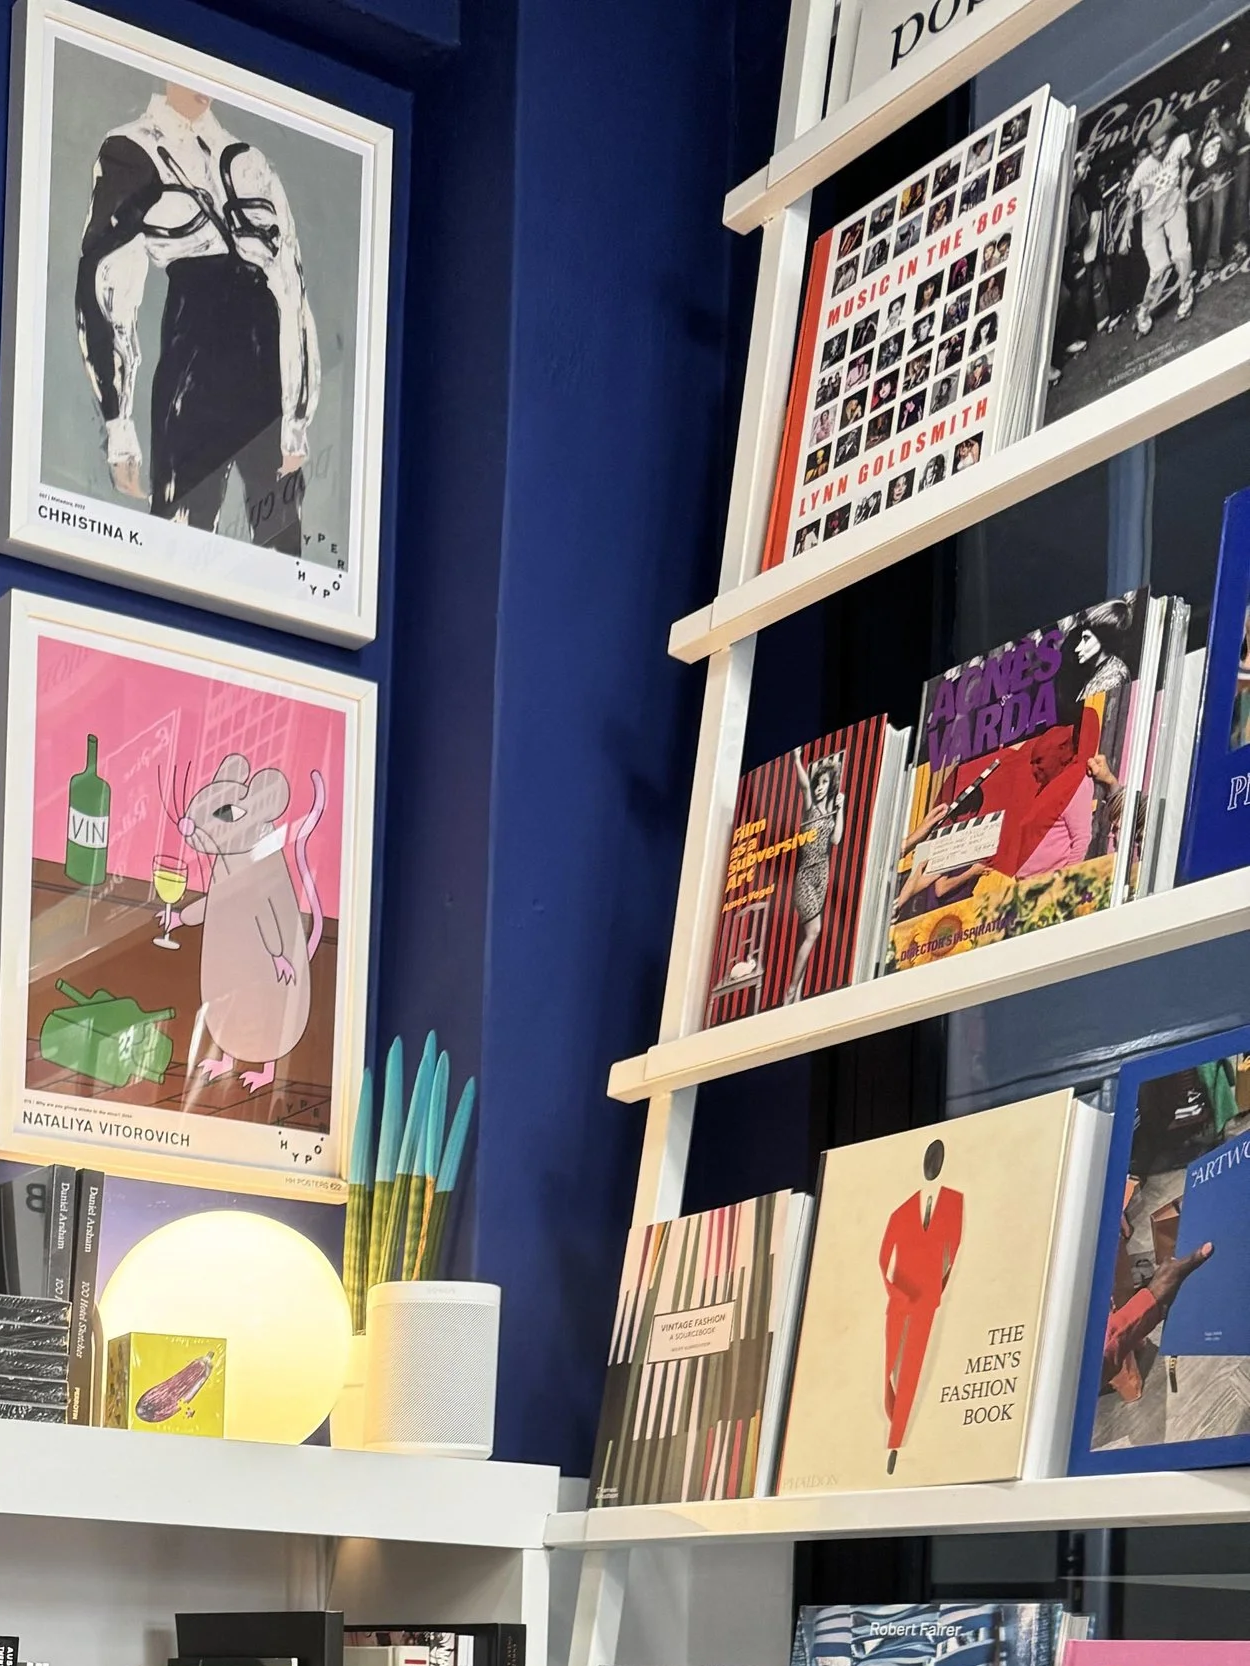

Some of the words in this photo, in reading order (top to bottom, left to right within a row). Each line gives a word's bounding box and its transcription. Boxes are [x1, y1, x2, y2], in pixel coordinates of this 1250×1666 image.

[826, 272, 889, 329] MUSIC
[897, 260, 918, 287] IN
[927, 230, 963, 274] THE
[972, 196, 1017, 241] '80S
[798, 472, 849, 519] LYNN
[857, 397, 988, 487] GOLDSMITH
[38, 505, 124, 542] CHRISTINA
[129, 531, 143, 547] K.
[926, 680, 1059, 774] VARDA
[72, 814, 106, 844] VIN
[732, 816, 767, 845] Film
[727, 826, 819, 877] Subversive
[725, 865, 756, 894] Art
[748, 882, 775, 902] Vogel
[22, 1110, 94, 1133] NATALIYA
[99, 1120, 191, 1148] VITOROVICH
[60, 1181, 70, 1213] Daniel
[87, 1185, 99, 1217] Daniel
[56, 1213, 68, 1251] Arsham
[84, 1217, 95, 1254] Arsham
[80, 1280, 90, 1297] 100
[78, 1299, 89, 1322] Hotel
[660, 1319, 694, 1333] VINTAGE
[694, 1313, 727, 1329] FASHION
[75, 1322, 87, 1359] Sketches
[988, 1324, 1025, 1346] THE
[964, 1350, 1021, 1375] MEN'S
[940, 1376, 1018, 1403] FASHION
[962, 1403, 1015, 1426] BOOK
[869, 1620, 917, 1638] Robert
[919, 1620, 963, 1639] Fairer
